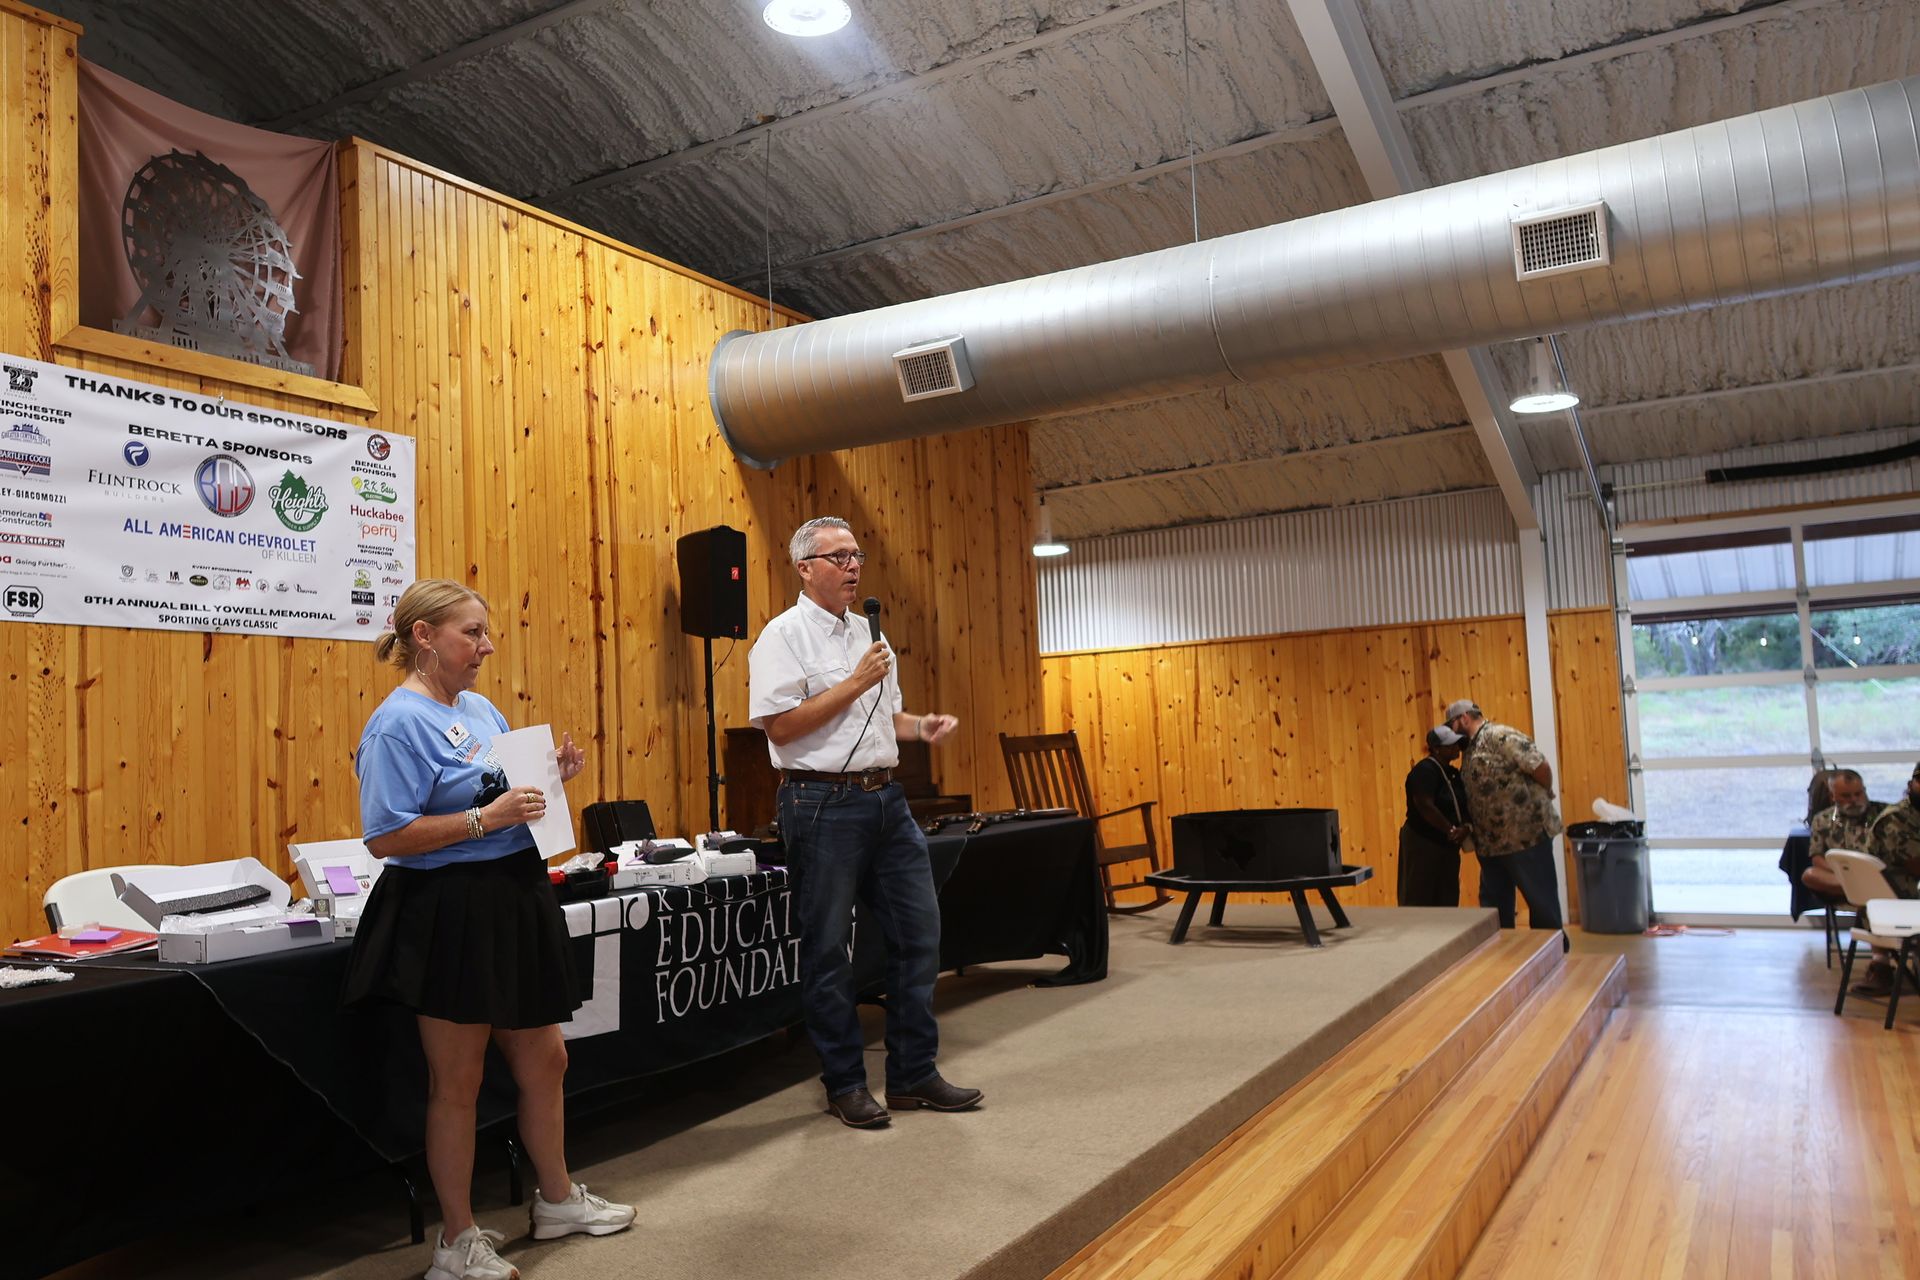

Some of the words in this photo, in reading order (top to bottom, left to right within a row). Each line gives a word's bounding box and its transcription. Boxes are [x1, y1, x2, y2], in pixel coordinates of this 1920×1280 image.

[65, 375, 165, 406] THANKS
[169, 397, 198, 412] TO
[201, 403, 244, 421] OUR
[247, 412, 348, 440] SPONSORS
[128, 424, 219, 449] BERETTA
[222, 440, 313, 465] SPONSORS
[351, 466, 397, 478] SPONSORS
[355, 460, 391, 470] BENELLI
[88, 469, 182, 495] FLINTROCK
[0, 487, 67, 504] EY-GIACOMOZZI
[269, 485, 329, 521] Heights
[0, 516, 52, 528] onstructors
[350, 504, 404, 522] Huckabee
[124, 518, 153, 535] ALL
[159, 523, 234, 544] AMERICAN
[238, 532, 316, 552] CHEVROLET
[362, 523, 397, 542] perry
[16, 558, 36, 567] Going
[261, 549, 275, 560] OF
[277, 551, 317, 563] KILLEEN
[7, 591, 39, 608] FSR
[84, 595, 113, 606] 8TH
[116, 598, 178, 610] ANNUAL
[180, 603, 211, 612] BILL
[213, 605, 267, 617] YOWELL
[269, 610, 337, 620] MEMORIAL
[158, 614, 209, 626] SPORTING
[212, 617, 241, 628] CLAYS
[243, 619, 279, 630] CLASSIC
[655, 891, 792, 967] EDUCAT
[655, 937, 802, 1023] FOUNDAT
